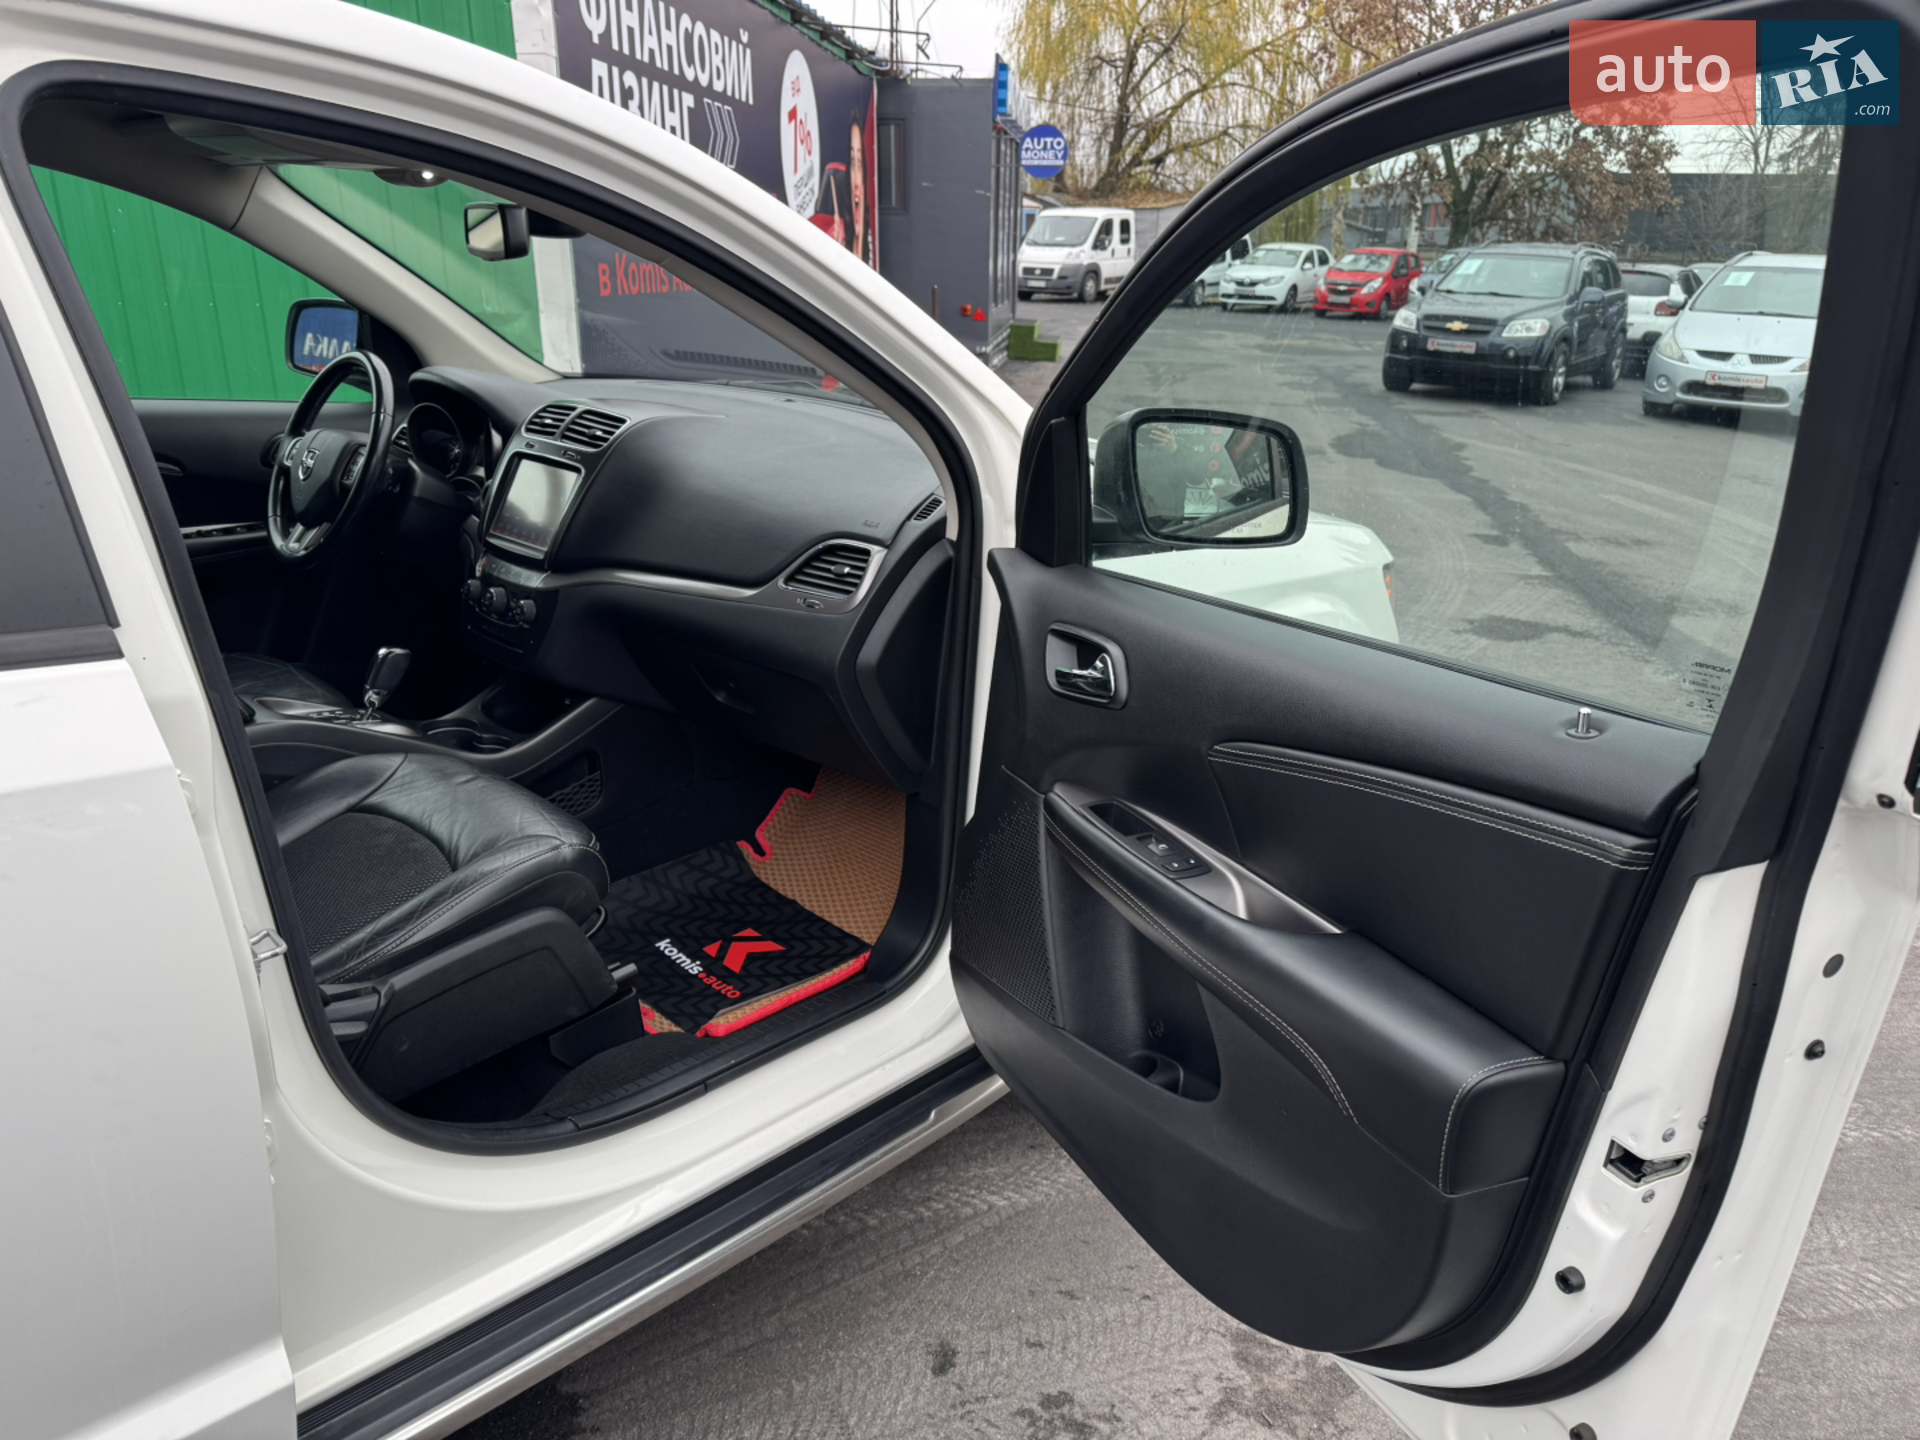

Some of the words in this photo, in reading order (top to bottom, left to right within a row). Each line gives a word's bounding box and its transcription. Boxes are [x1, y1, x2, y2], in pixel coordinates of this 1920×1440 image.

[578, 0, 754, 105] ФІНАНСОВИЙ
[1021, 137, 1066, 150] AUTO
[1021, 150, 1065, 160] MONEY
